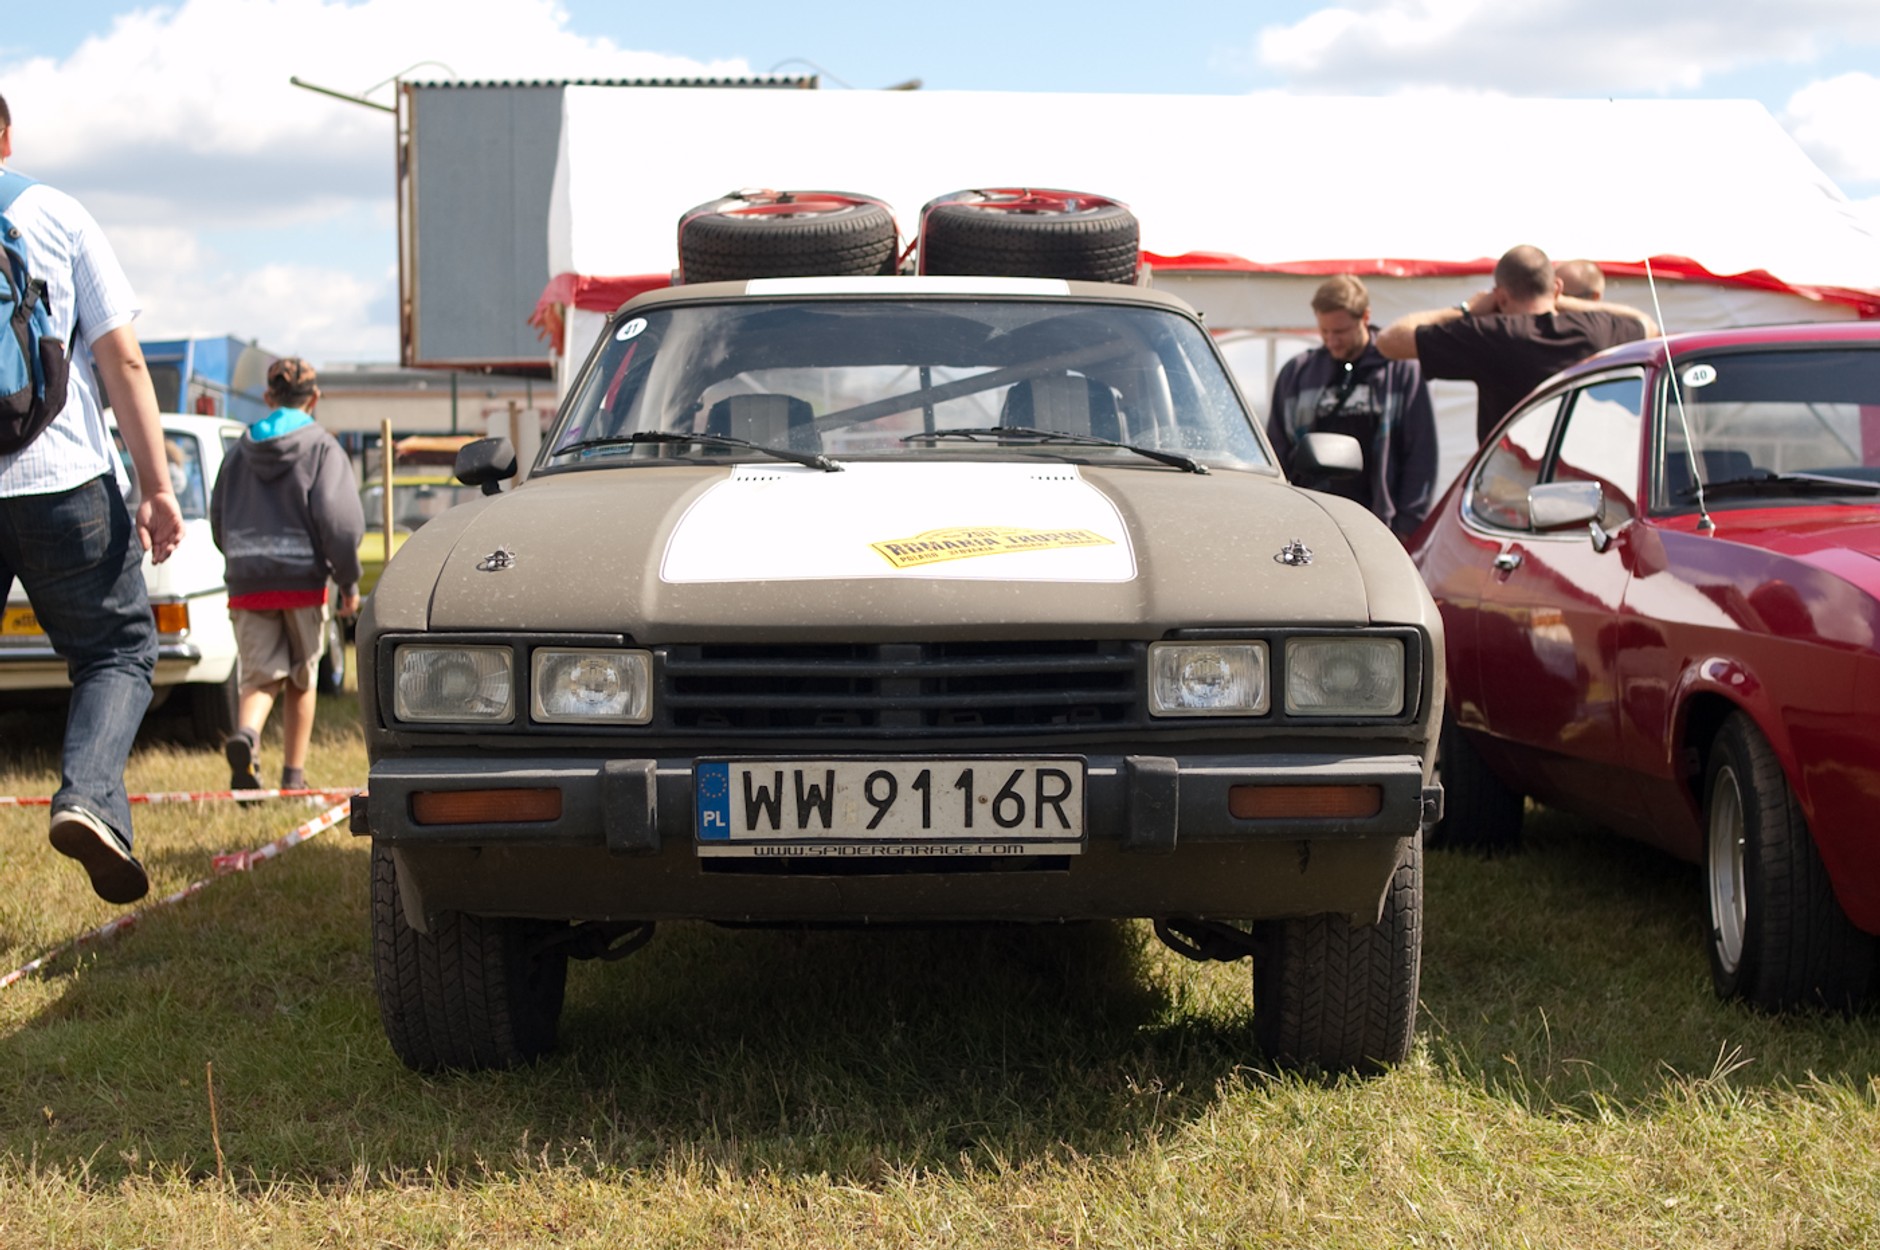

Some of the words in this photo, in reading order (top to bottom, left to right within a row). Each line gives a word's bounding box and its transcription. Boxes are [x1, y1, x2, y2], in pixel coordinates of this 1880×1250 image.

[885, 536, 1001, 556] ROMANIA
[742, 769, 835, 831] WW
[864, 768, 1073, 831] 9116R
[703, 810, 726, 828] PL
